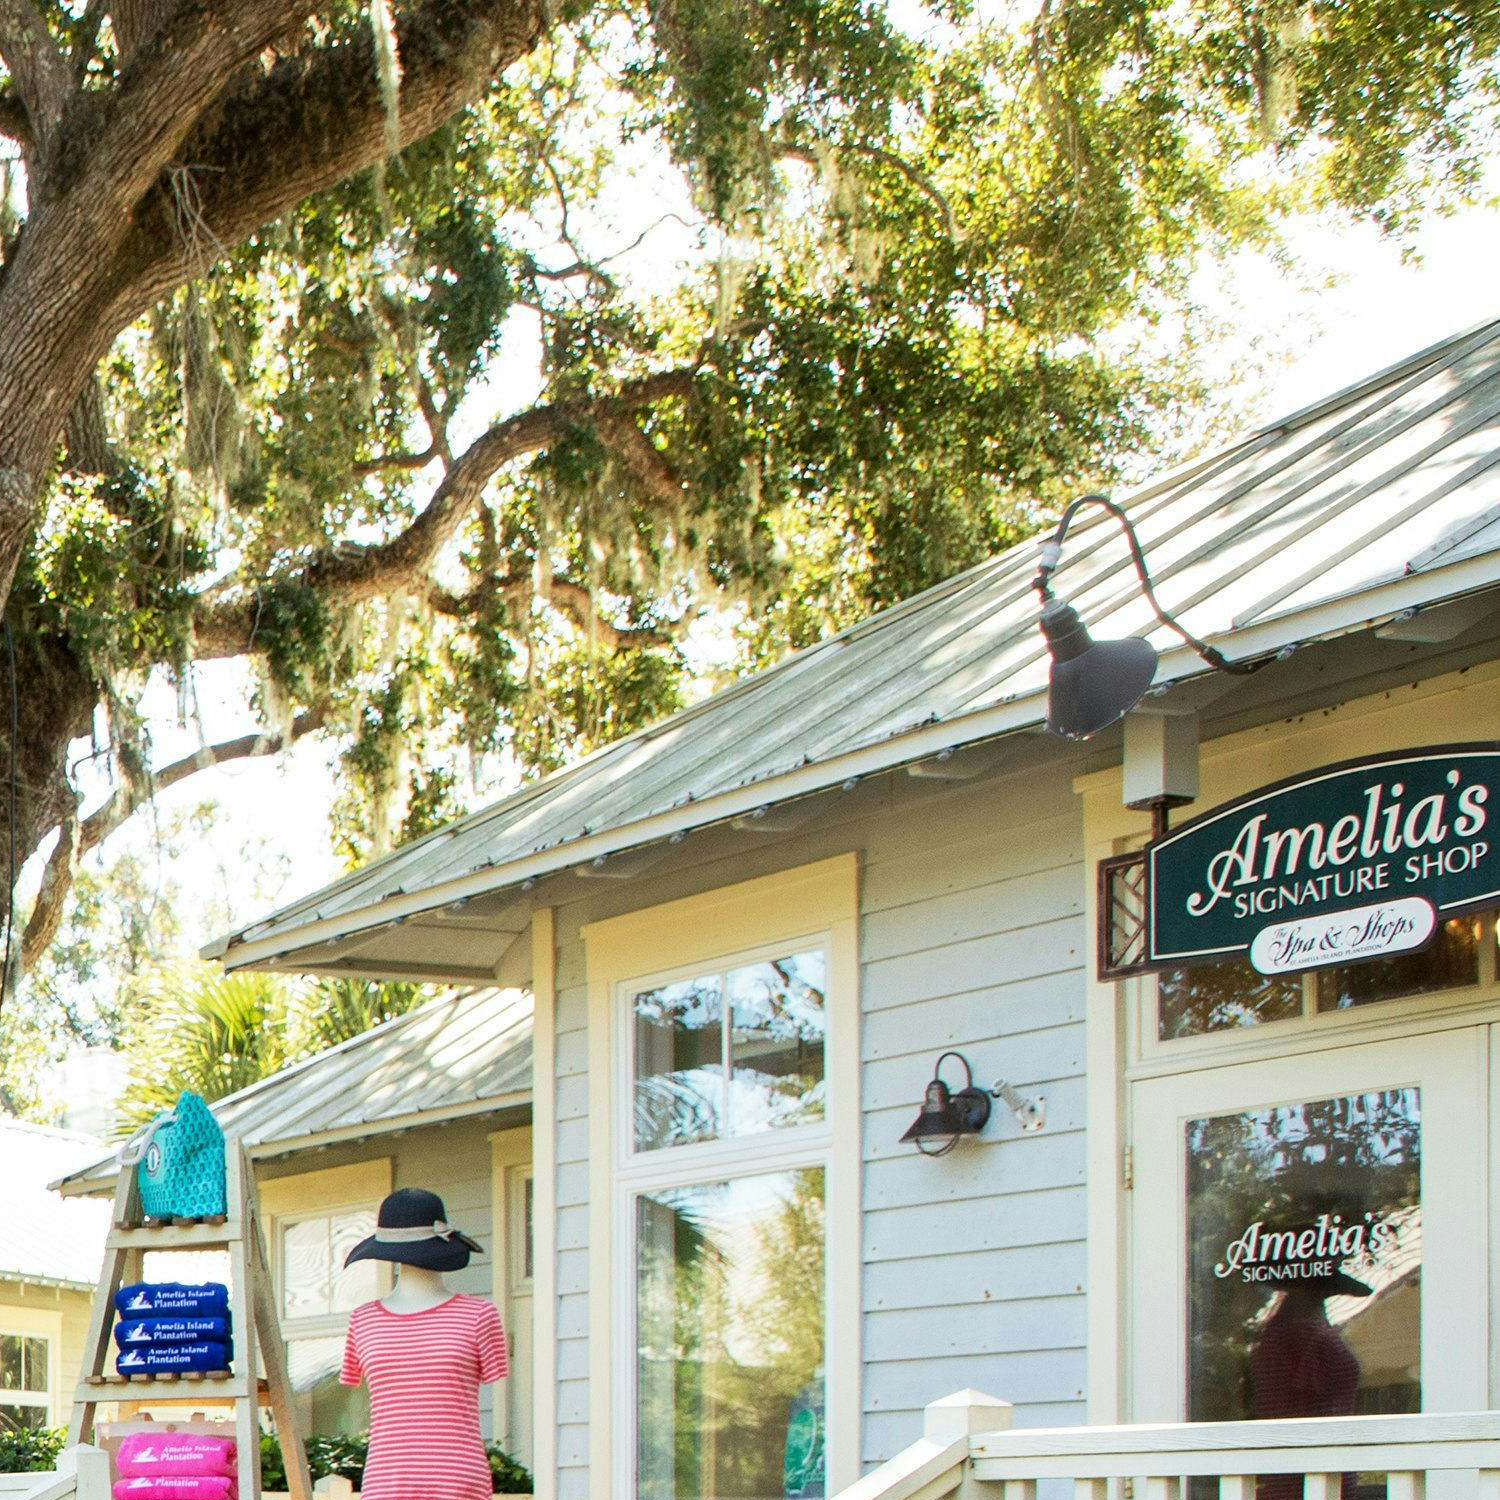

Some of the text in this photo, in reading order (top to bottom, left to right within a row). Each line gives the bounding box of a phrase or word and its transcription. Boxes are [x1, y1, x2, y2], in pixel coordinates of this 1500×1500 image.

[1186, 769, 1490, 917] Amelia's
[1233, 842, 1490, 919] SIGNATURE SHOP
[1268, 908, 1417, 967] Spa & Shops
[1213, 1212, 1389, 1278] Amelia's
[1241, 1260, 1334, 1283] SIGNATURE
[155, 1290, 215, 1299] Amelia Island
[154, 1299, 198, 1308] Plantation
[154, 1321, 214, 1331] Amelia Island
[153, 1331, 198, 1340] Plantation
[181, 1346, 208, 1354] Island
[147, 1355, 191, 1364] Plantation
[160, 1453, 204, 1462] Plantation
[155, 1478, 199, 1487] Plantation
